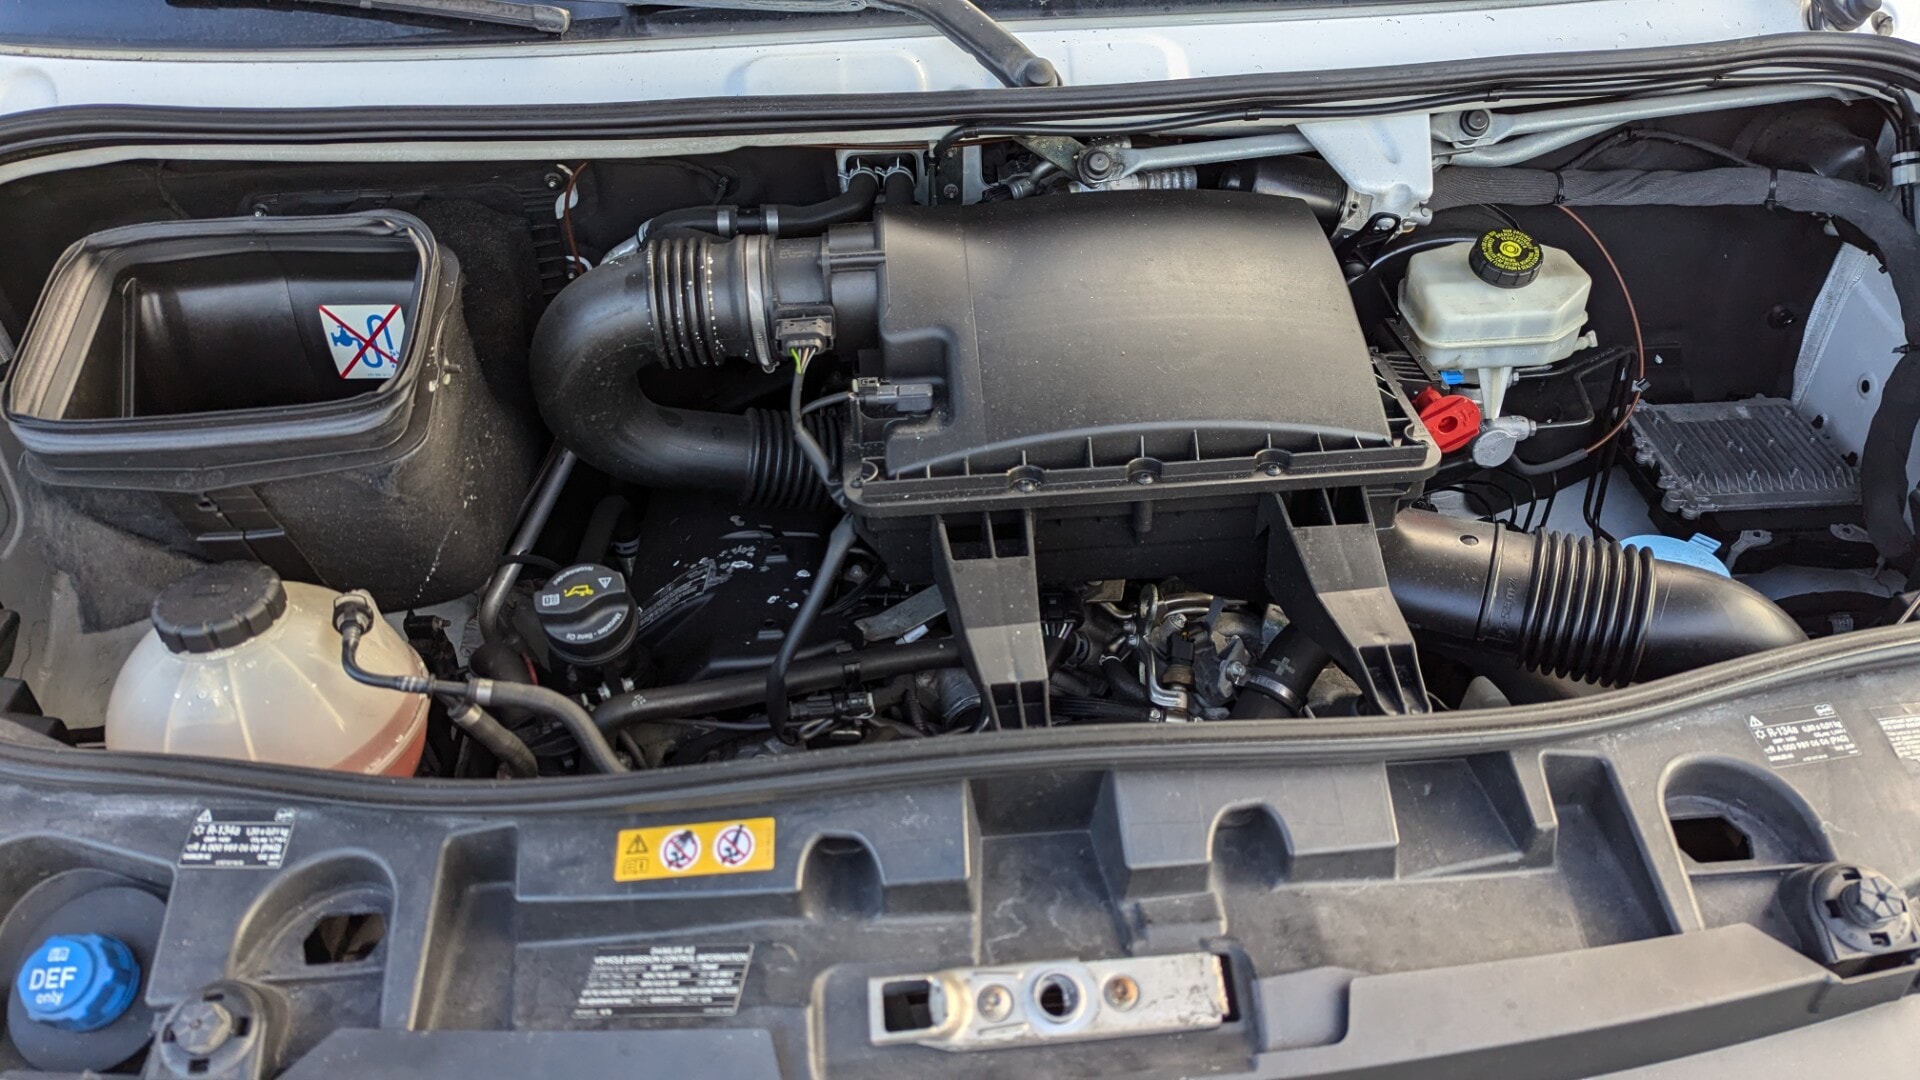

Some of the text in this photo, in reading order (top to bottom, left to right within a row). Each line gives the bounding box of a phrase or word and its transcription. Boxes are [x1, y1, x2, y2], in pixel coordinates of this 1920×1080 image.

[1767, 726, 1799, 738] R-134a
[696, 953, 749, 963] INFORMATION
[29, 966, 78, 991] DEF
[35, 990, 64, 1007] only
